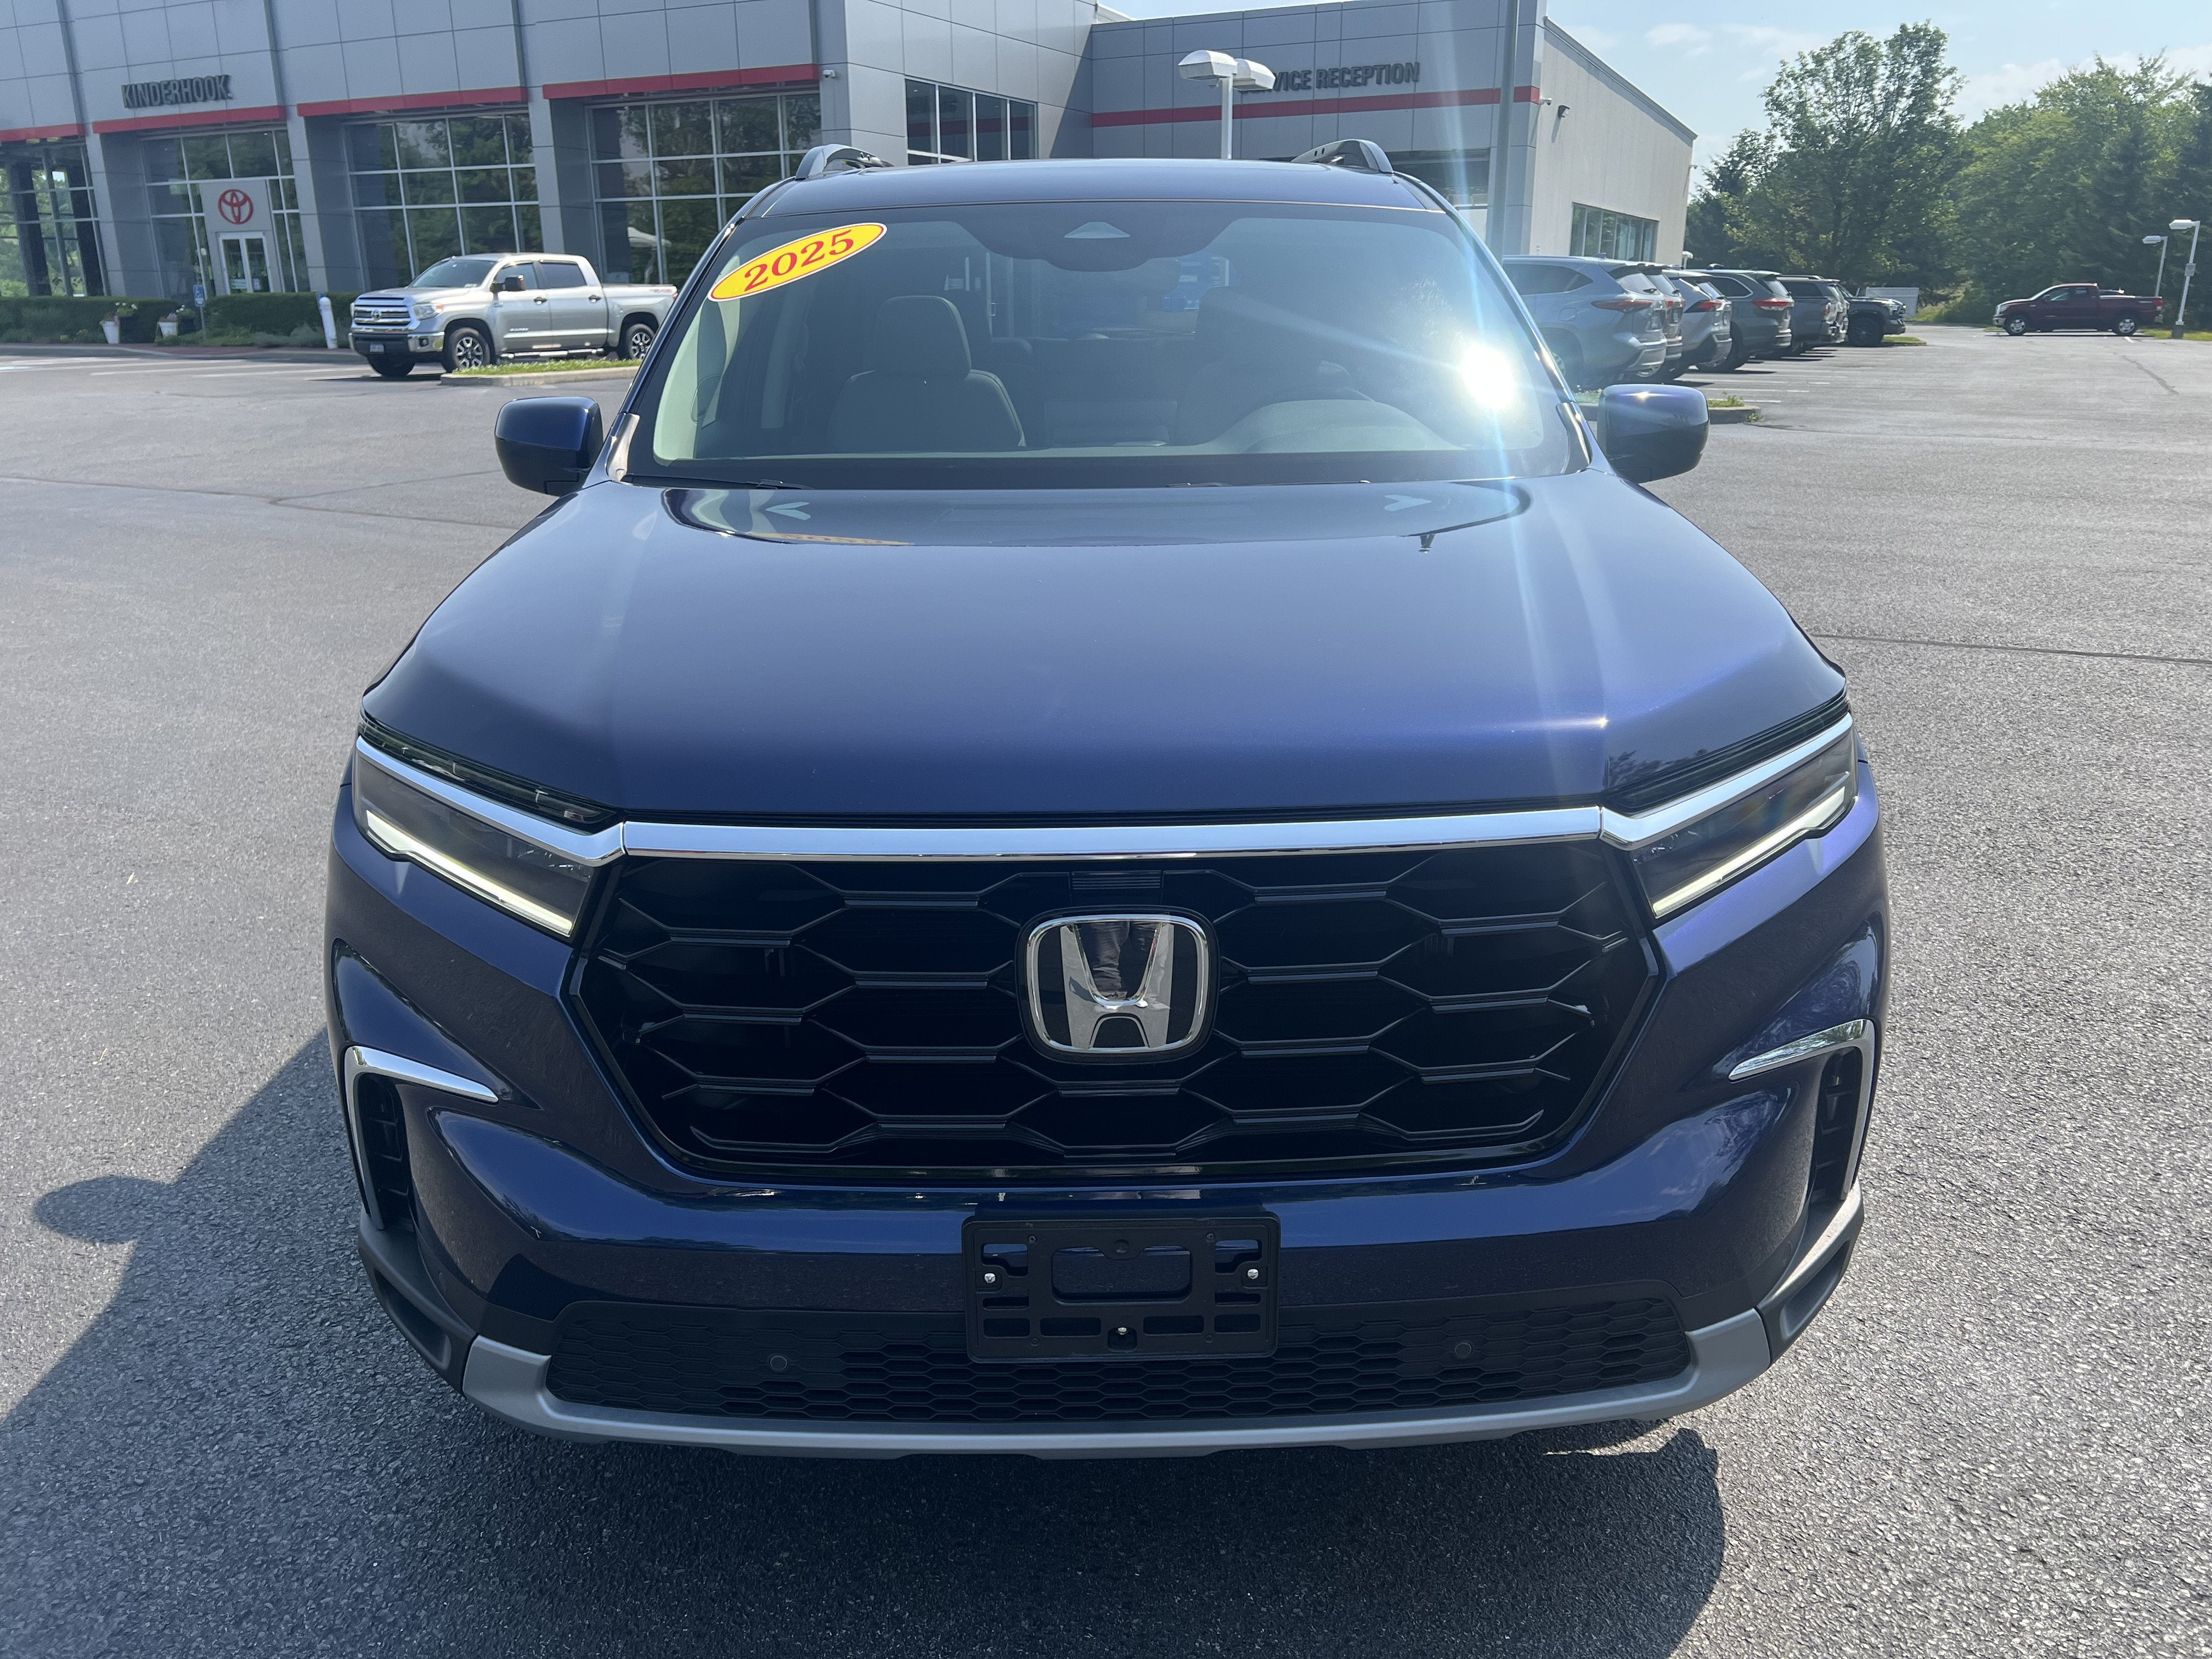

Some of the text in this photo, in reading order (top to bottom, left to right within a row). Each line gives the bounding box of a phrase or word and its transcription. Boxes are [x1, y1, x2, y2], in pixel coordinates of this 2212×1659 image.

[121, 74, 233, 108] KINDERHOOK
[1239, 62, 1420, 93] VICE RECEPTION
[744, 229, 854, 292] 2025
